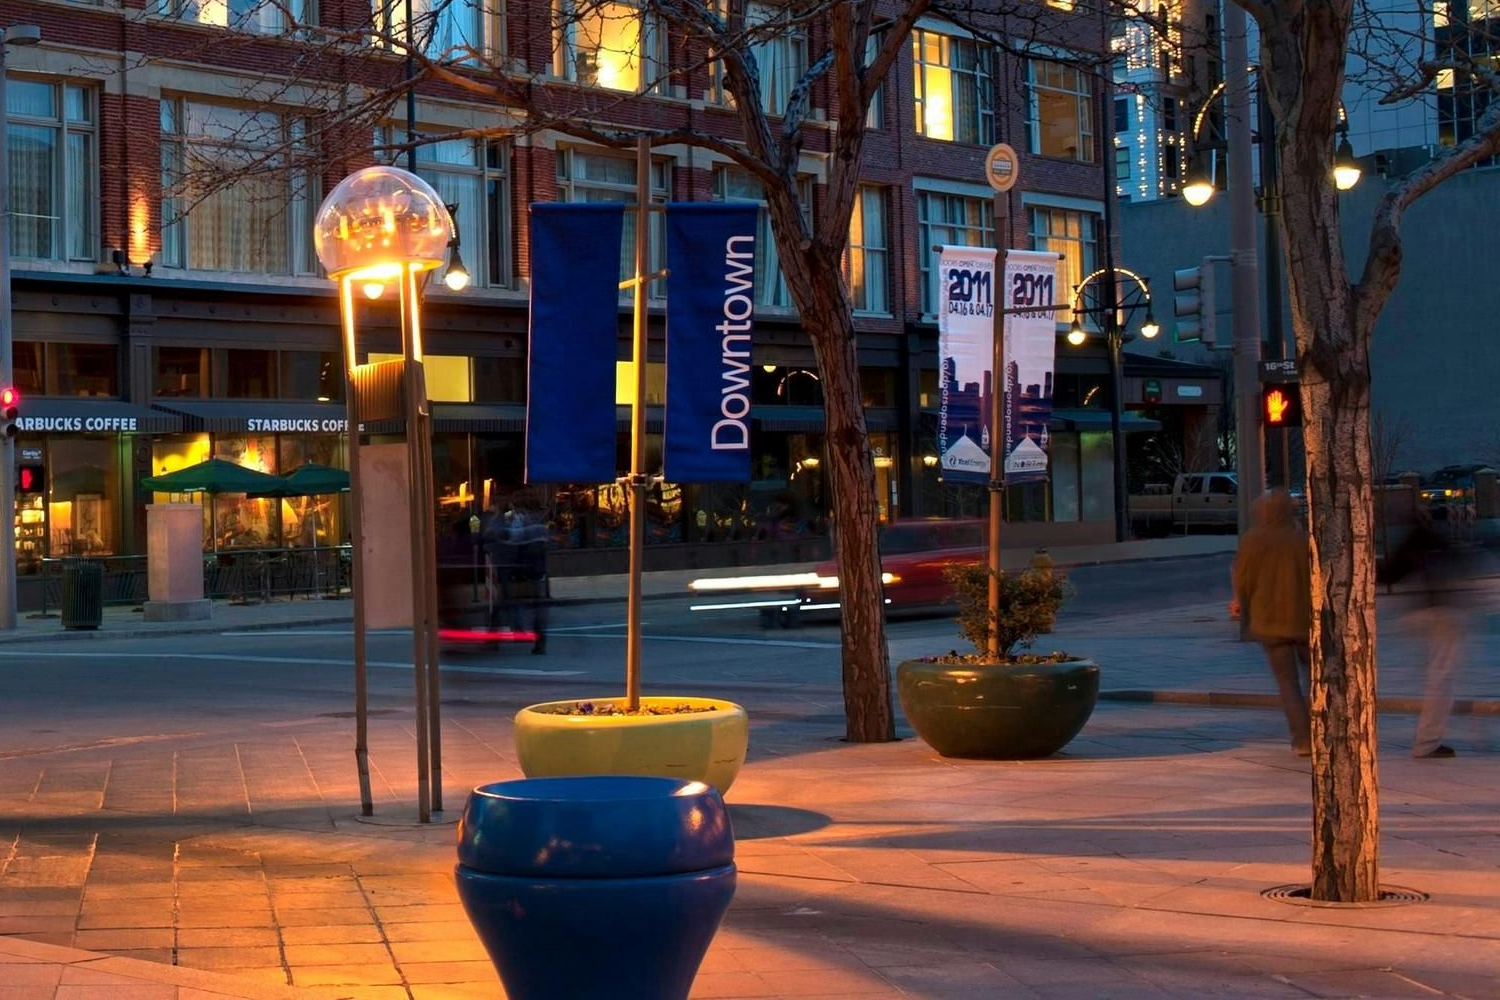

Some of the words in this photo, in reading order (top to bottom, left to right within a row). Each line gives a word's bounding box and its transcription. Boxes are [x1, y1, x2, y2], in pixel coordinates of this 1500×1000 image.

[948, 268, 991, 304] 2011
[1013, 273, 1053, 306] 2011
[948, 301, 968, 316] 04.16
[969, 303, 974, 315] &
[975, 303, 994, 318] 04.17
[711, 235, 754, 450] Downtown
[15, 417, 82, 431] ARBUCKS
[85, 417, 137, 431] COFFEE
[247, 418, 319, 432] STARBUCKS
[322, 419, 365, 432] COFFE
